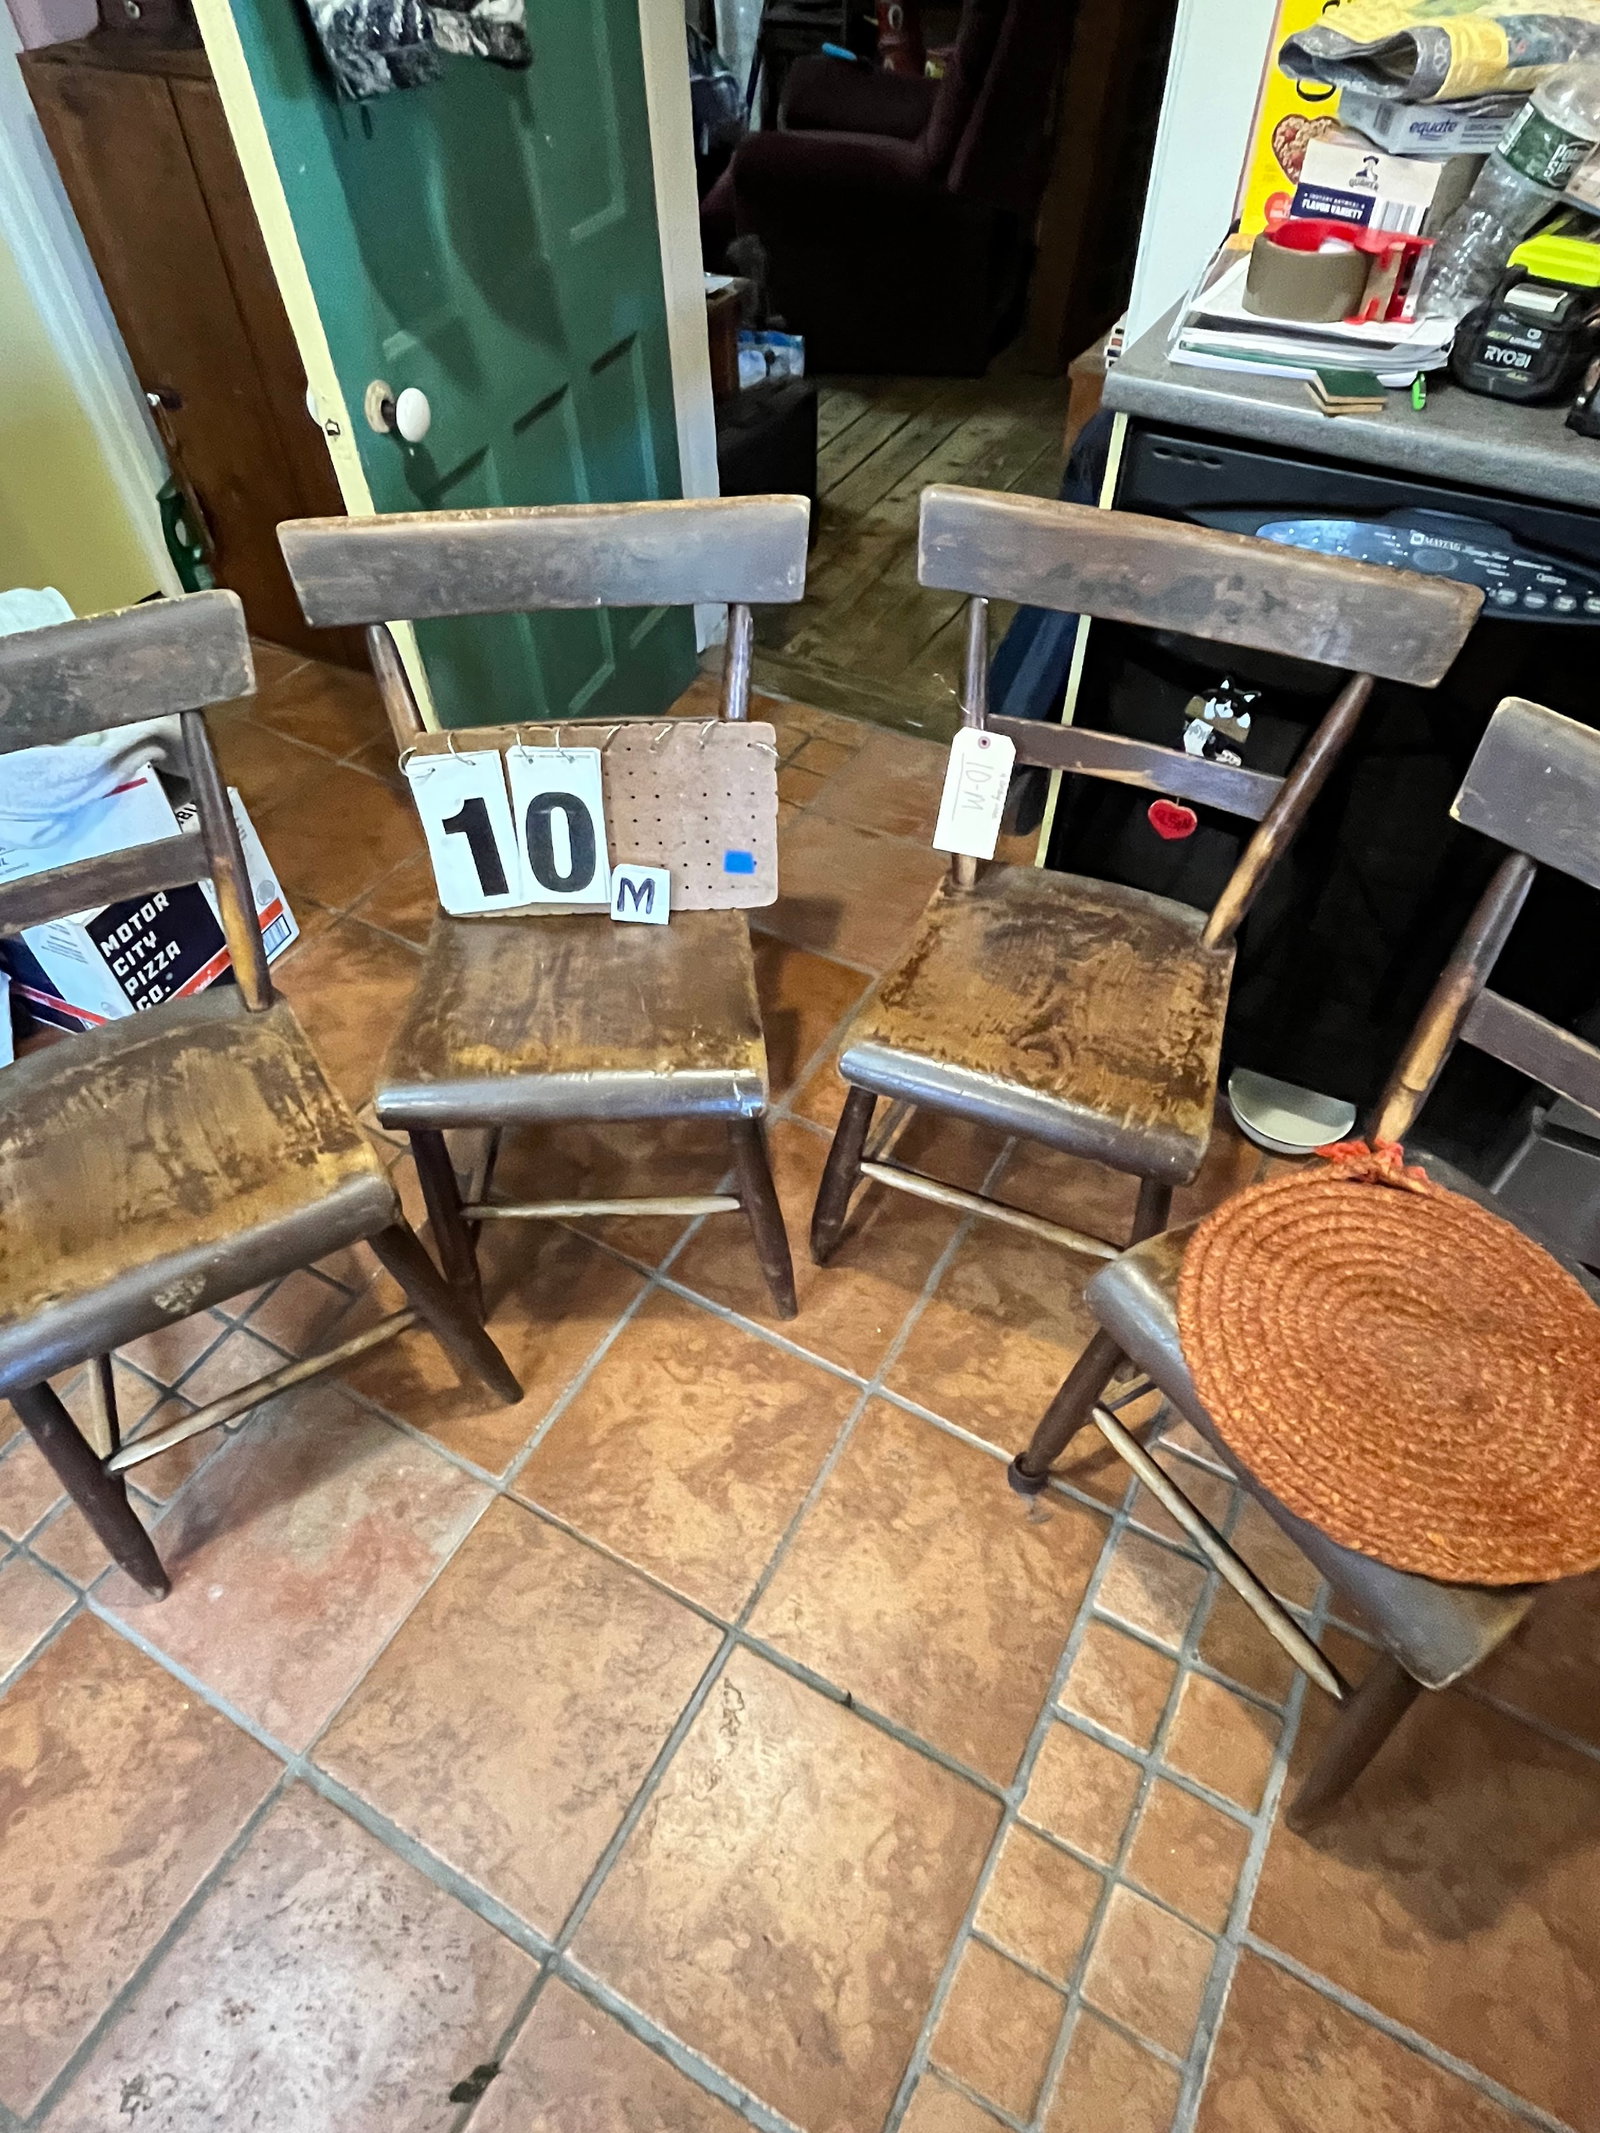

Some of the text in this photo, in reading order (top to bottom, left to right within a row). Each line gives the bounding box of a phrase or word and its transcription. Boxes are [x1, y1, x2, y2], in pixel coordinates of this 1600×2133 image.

[1409, 120, 1458, 135] equate
[1302, 198, 1330, 214] FLAVOR
[1330, 203, 1364, 220] VARIETY
[1484, 344, 1532, 368] RYOBI
[1423, 535, 1461, 551] MAYTAG
[441, 791, 596, 897] 10
[617, 877, 655, 914] M
[100, 891, 170, 958] MOTOR
[112, 930, 157, 977] CITY
[124, 940, 181, 996] PIZZA
[136, 984, 171, 1011] CO.
